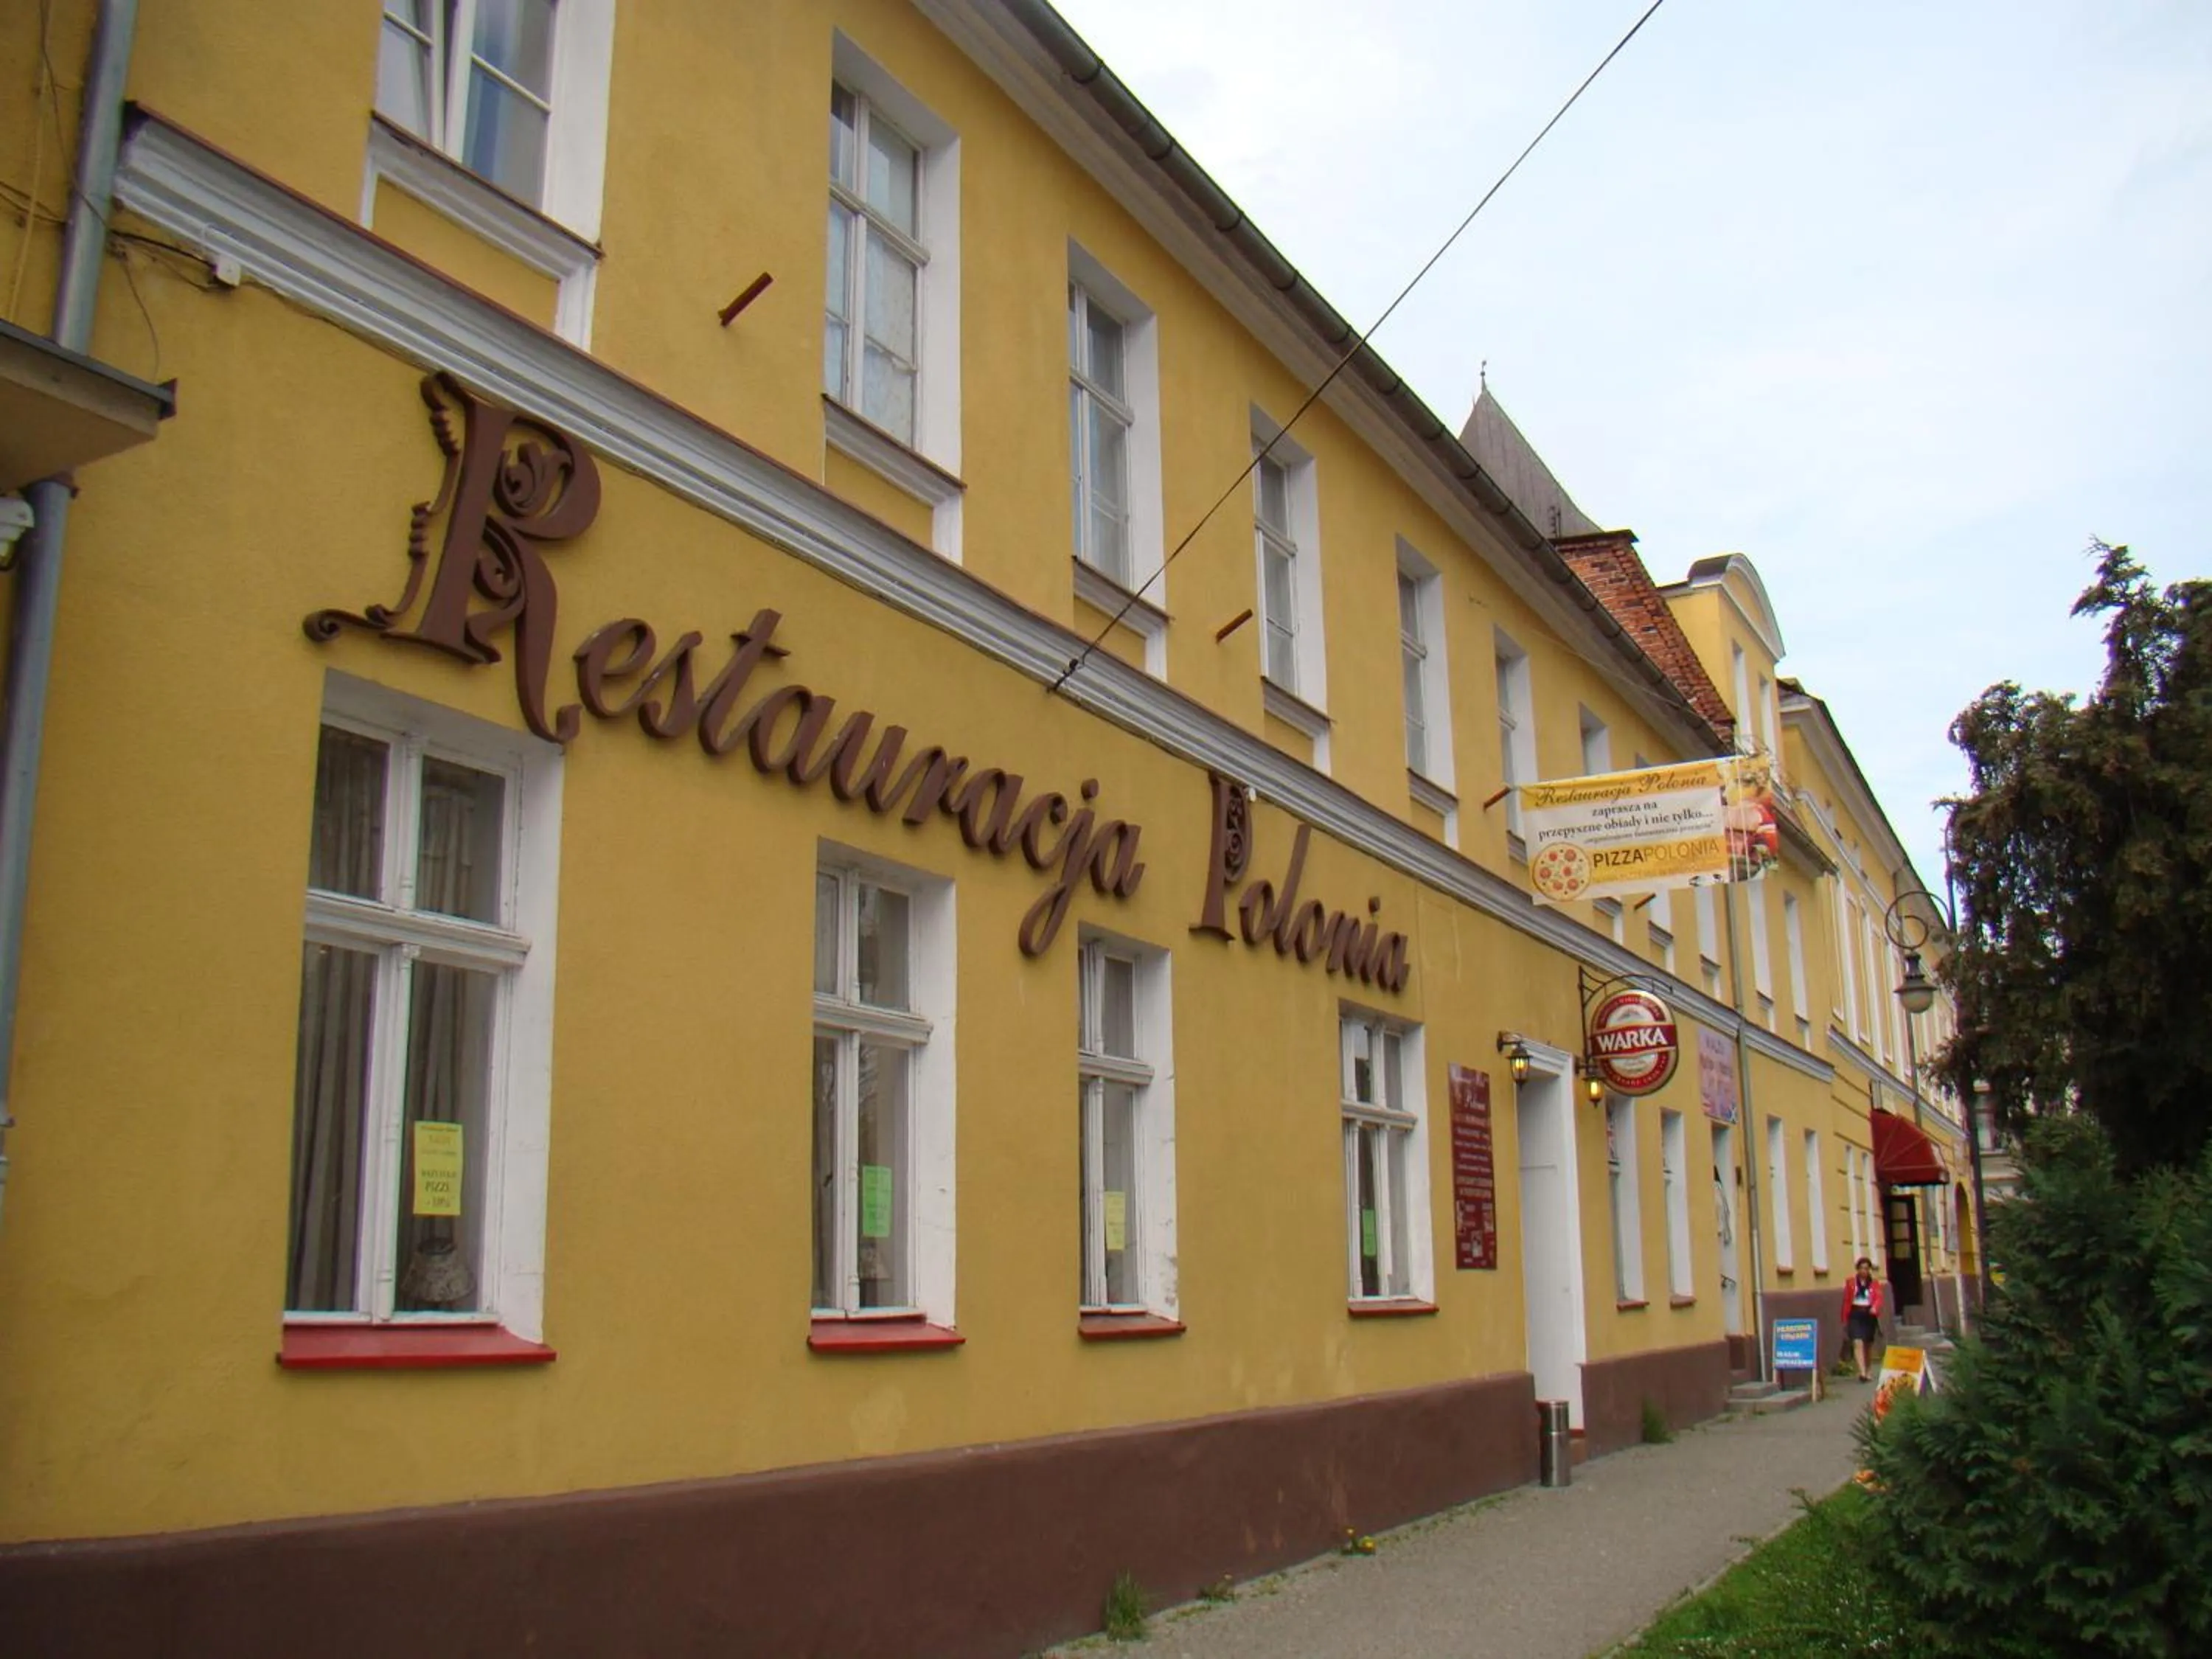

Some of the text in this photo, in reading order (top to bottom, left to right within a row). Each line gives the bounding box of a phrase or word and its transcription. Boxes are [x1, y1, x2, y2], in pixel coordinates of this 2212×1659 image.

[302, 369, 1411, 993] Restauracja Polonia
[1534, 771, 1708, 808] Restauracja Polonia
[1592, 801, 1658, 818] zaprasza na
[1538, 823, 1603, 842] przepyszne
[1604, 815, 1643, 831] obiady
[1644, 813, 1649, 825] i
[1597, 1026, 1668, 1053] WARKA
